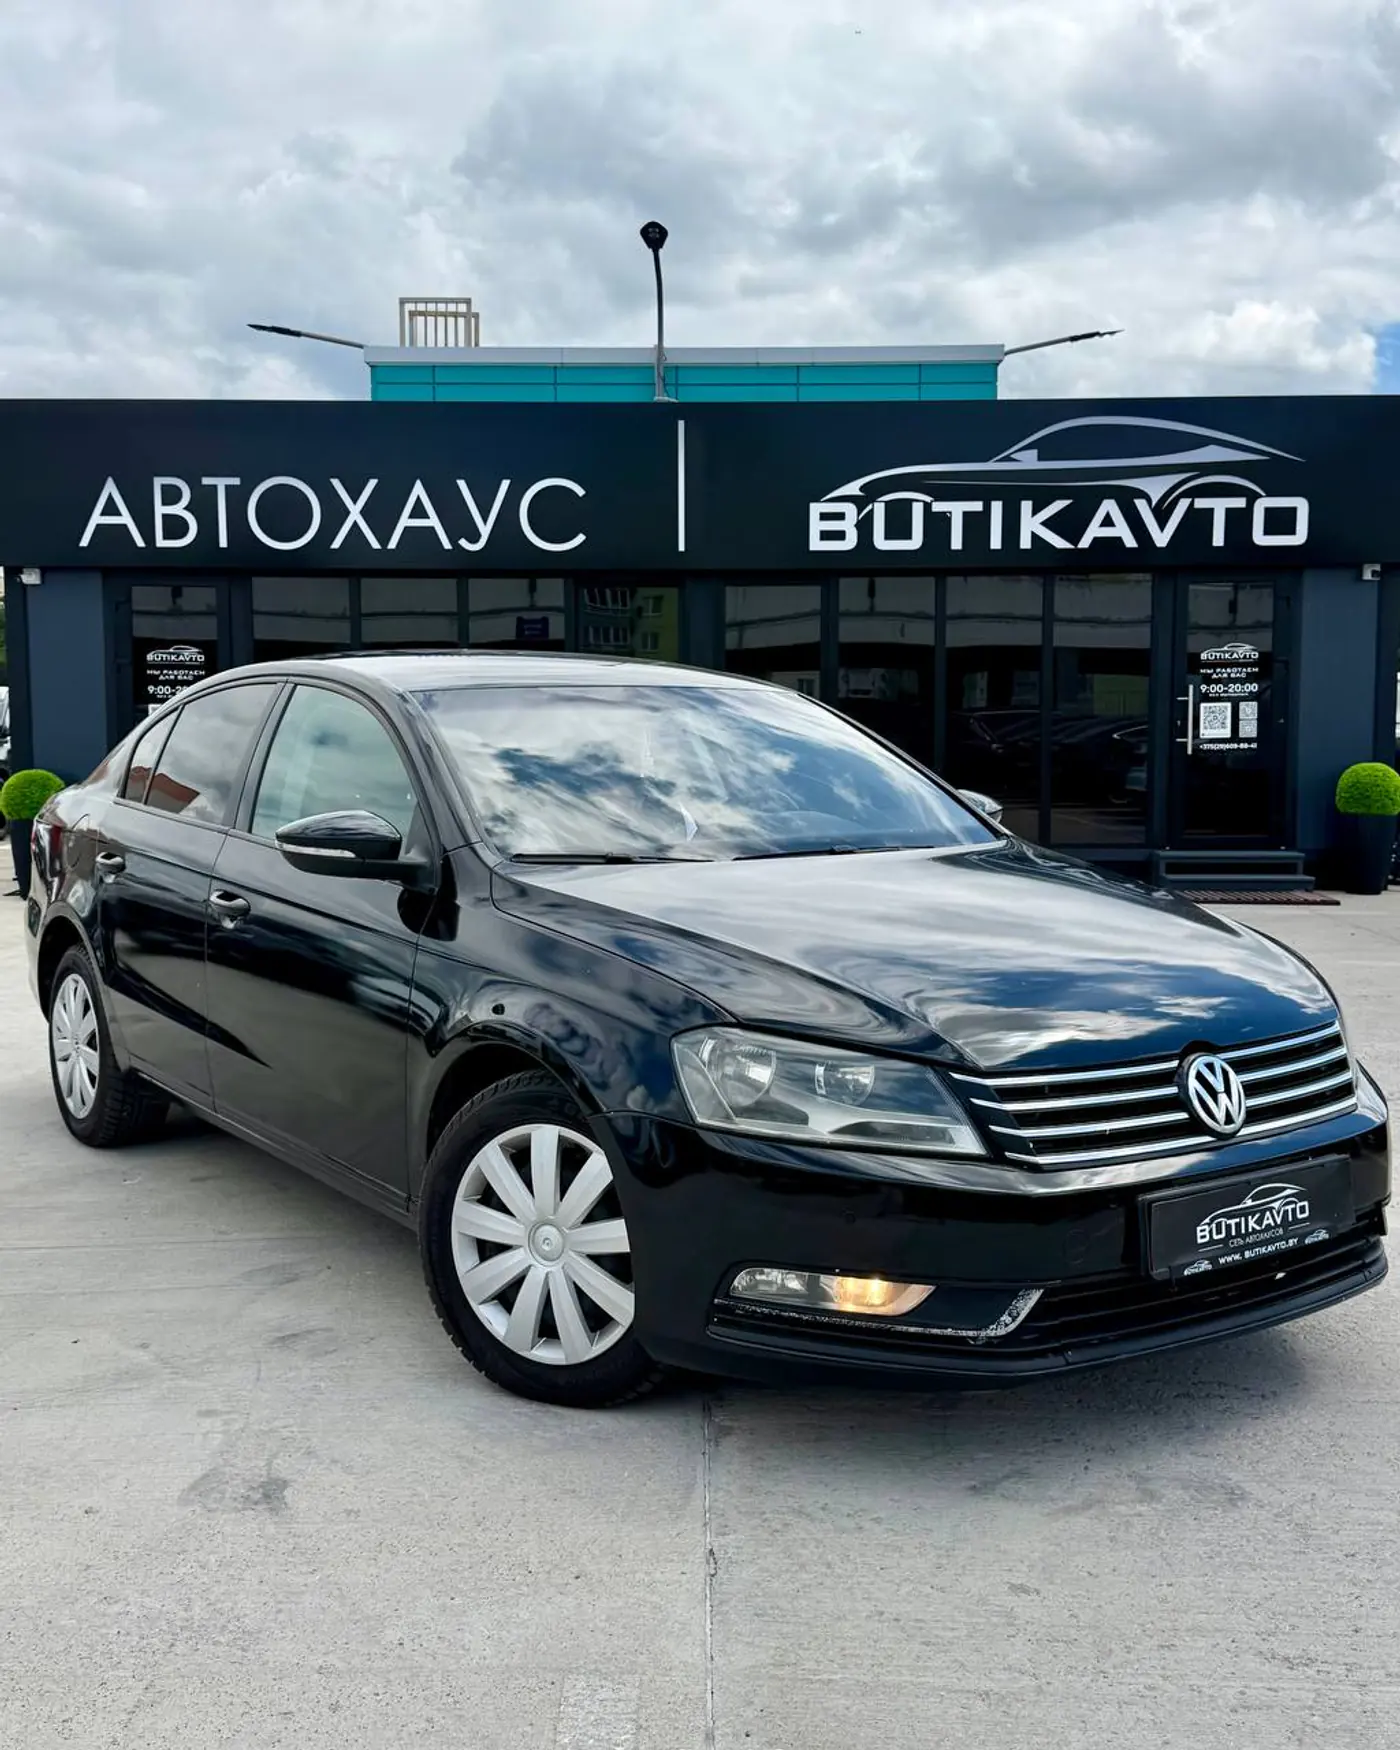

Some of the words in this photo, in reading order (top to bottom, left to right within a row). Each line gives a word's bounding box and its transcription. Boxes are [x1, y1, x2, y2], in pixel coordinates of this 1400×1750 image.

[79, 476, 587, 552] АВТОХАУС
[808, 495, 1310, 552] BUTIKAVTO
[146, 653, 205, 662] BUTIKAVTO
[1200, 652, 1259, 660] BUTIKAVTO
[1199, 683, 1259, 694] 9:00-20:00
[1196, 1200, 1310, 1245] BUTIKAVTO
